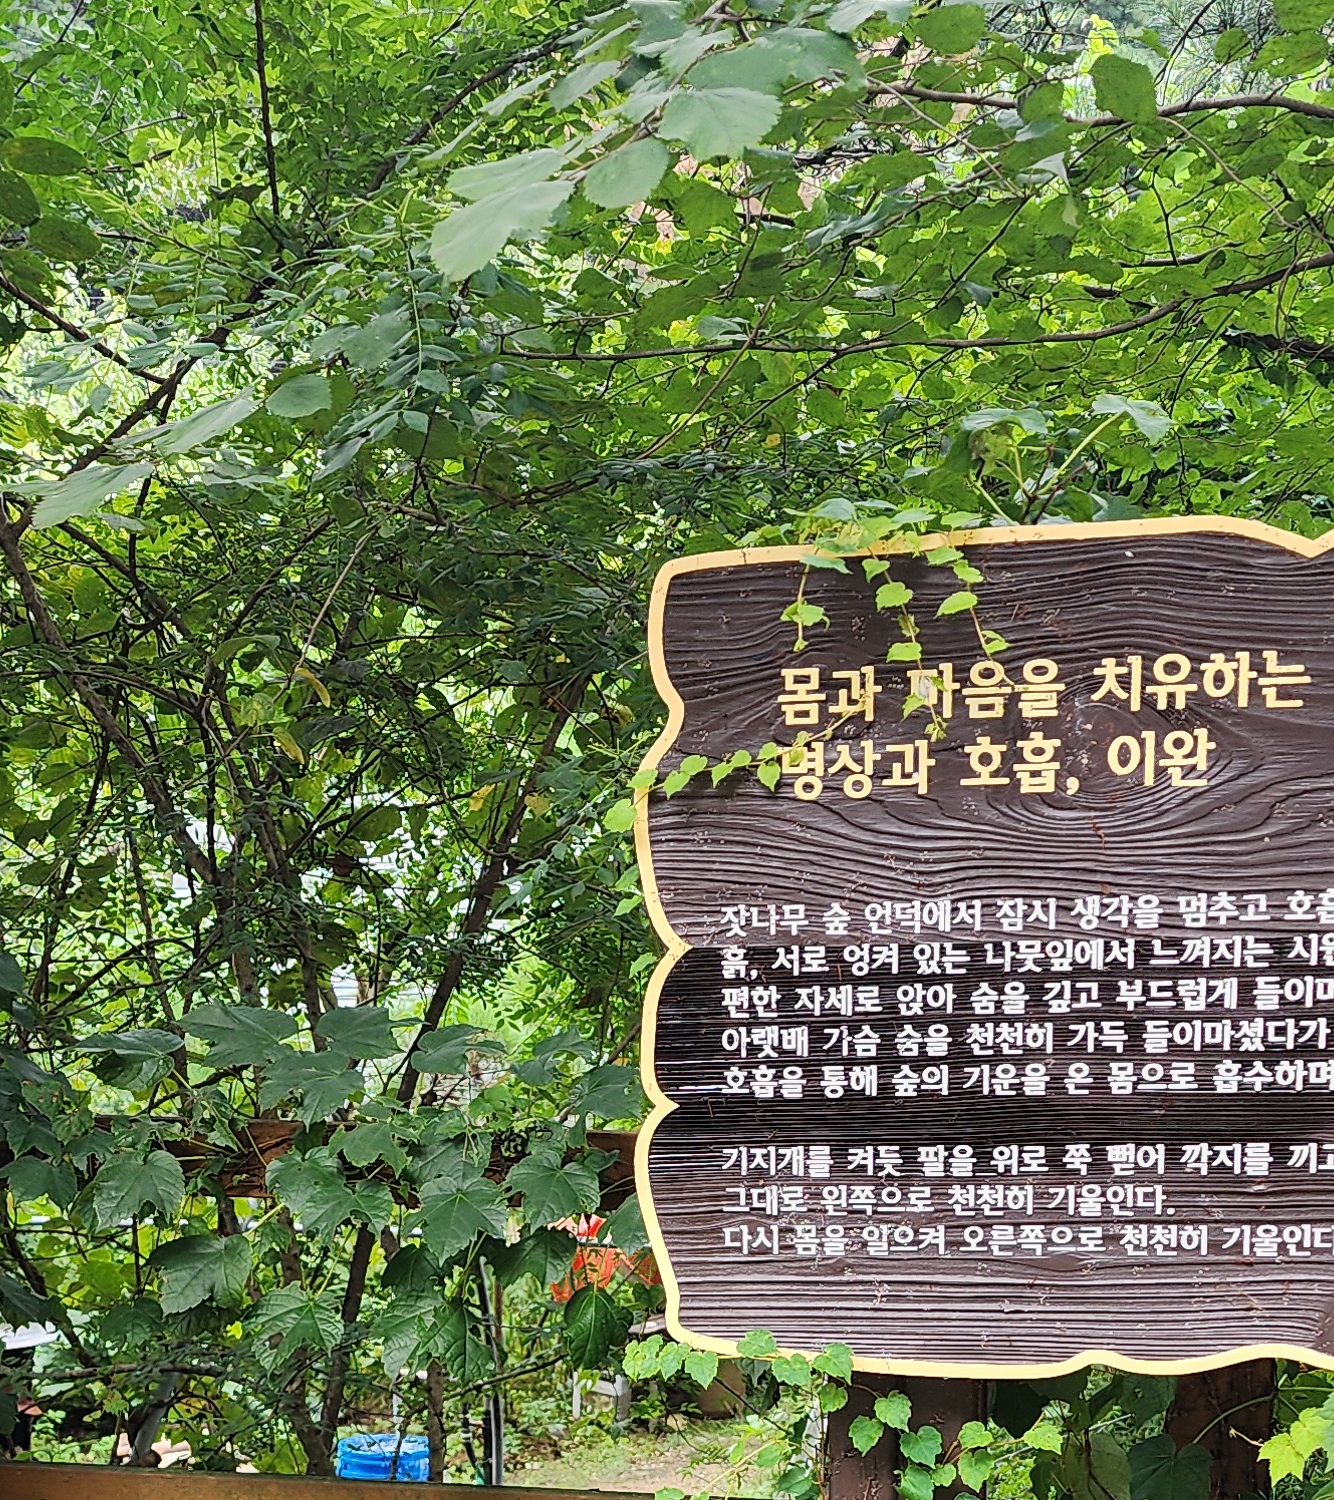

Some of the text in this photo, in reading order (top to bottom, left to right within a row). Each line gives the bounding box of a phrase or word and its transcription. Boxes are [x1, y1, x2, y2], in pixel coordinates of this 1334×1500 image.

[777, 649, 1312, 726] 몸과 마음을 치유하는
[780, 727, 1217, 801] 명상과 호흡, 이완
[720, 903, 809, 937] 잣나무
[822, 903, 851, 935] 숲
[864, 899, 982, 934] 언덕에서
[995, 898, 1056, 931] 잠시
[1070, 895, 1163, 930] 생각을
[1178, 893, 1270, 927] 멈추고
[771, 944, 829, 977] 서로
[843, 943, 899, 977] 엉켜
[913, 943, 971, 975] 있는
[986, 938, 1135, 971] 나뭇잎에서
[1149, 935, 1273, 968] 느껴지는
[721, 986, 781, 1018] 편한
[794, 984, 883, 1017] 자세로
[896, 983, 956, 1015] 앉아
[969, 981, 1030, 1015] 숨을
[1043, 982, 1103, 1013] 깊고
[1116, 977, 1238, 1011] 부드럽게
[721, 1025, 809, 1058] 아랫배
[822, 1025, 881, 1057] 가슴
[894, 1023, 953, 1057] 숨을
[966, 1022, 1054, 1055] 천천히
[1068, 1020, 1129, 1054] 가득
[1142, 1017, 1331, 1053] 들이마셨다가
[722, 1066, 807, 1099] 호흡을
[821, 1065, 878, 1098] 통해
[892, 1064, 949, 1098] 숲의
[963, 1063, 1050, 1097] 기운을
[1064, 1062, 1094, 1094] 온
[1109, 1062, 1198, 1095] 몸으로
[721, 1145, 834, 1178] 기지개를
[847, 1145, 903, 1177] 켜듯
[917, 1144, 978, 1177] 팔을
[990, 1144, 1050, 1176] 위로
[1062, 1144, 1093, 1176] 쭉
[1106, 1143, 1165, 1176] 뻗어
[1180, 1143, 1274, 1176] 깍지를
[722, 1183, 1176, 1216] 그대로 왼쪽으로 천천히 기울인다.
[722, 1224, 781, 1256] 다시
[793, 1225, 849, 1256] 몸을
[861, 1224, 946, 1256] 일으켜
[959, 1225, 1107, 1256] 오른쪽으로
[1119, 1224, 1208, 1257] 천천히
